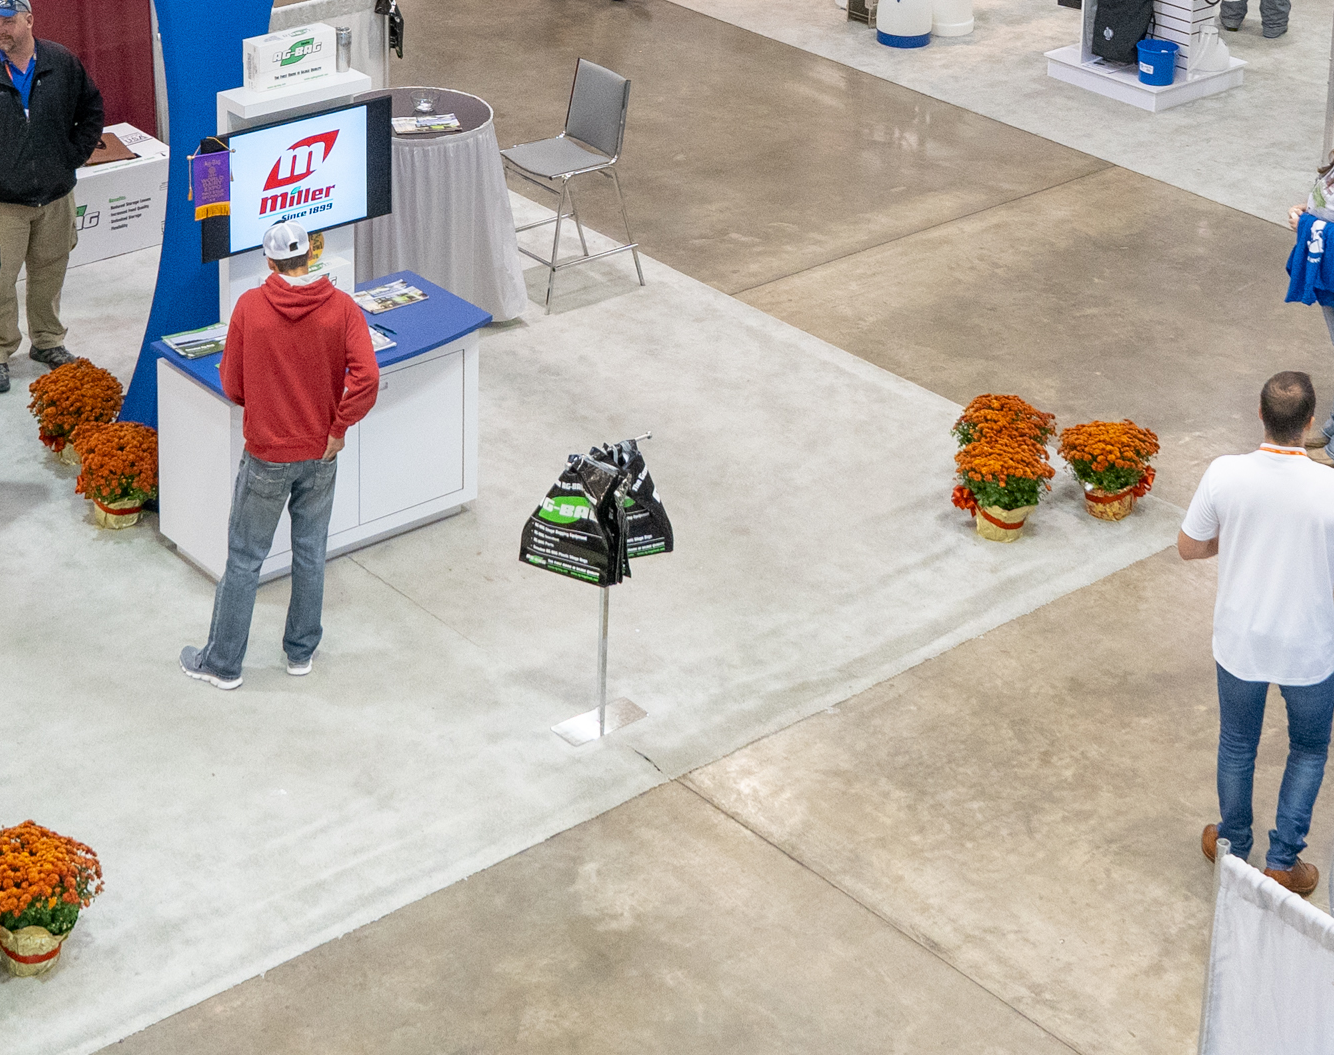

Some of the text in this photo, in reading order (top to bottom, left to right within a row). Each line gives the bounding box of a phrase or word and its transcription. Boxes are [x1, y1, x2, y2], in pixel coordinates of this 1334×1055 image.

[271, 41, 323, 63] AG-BAG
[259, 182, 336, 216] miller
[308, 201, 334, 217] 1899
